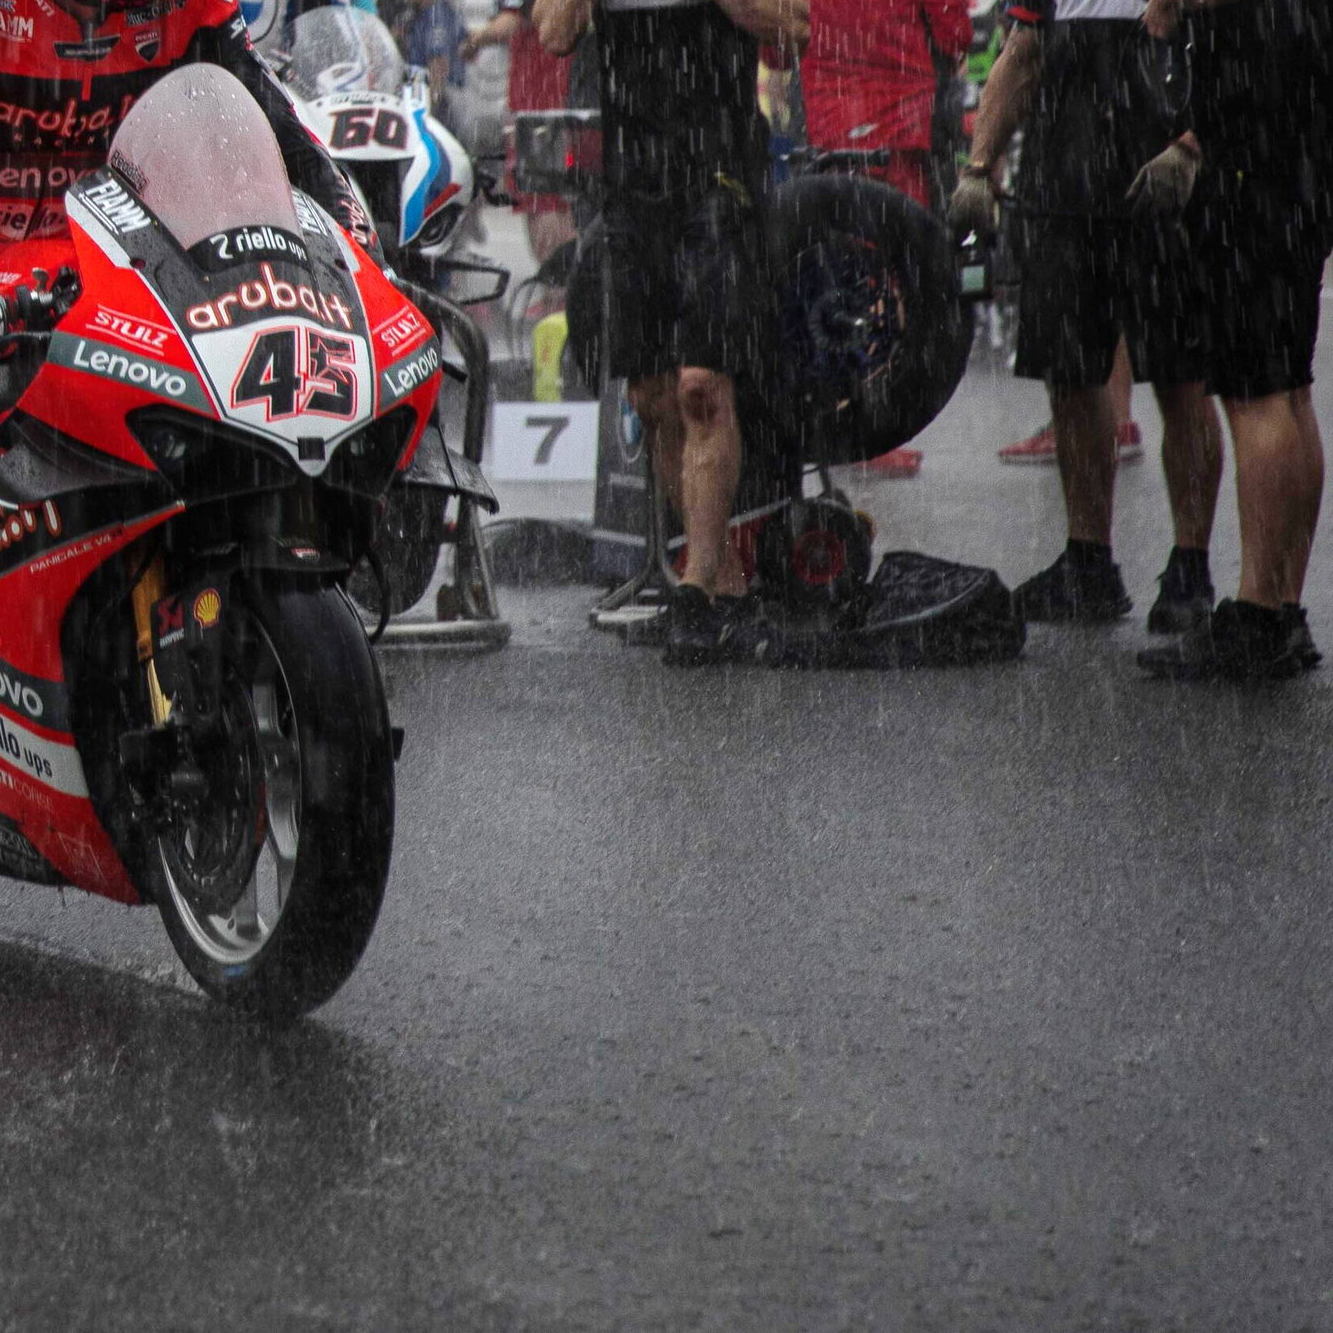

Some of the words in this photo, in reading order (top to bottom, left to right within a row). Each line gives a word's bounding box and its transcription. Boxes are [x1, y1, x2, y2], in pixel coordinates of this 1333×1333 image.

[328, 108, 409, 151] 60
[85, 178, 152, 234] FIAMM
[235, 226, 285, 252] riello
[288, 240, 308, 262] ups
[95, 311, 169, 348] STULZ
[73, 339, 187, 397] Lenovo
[230, 324, 358, 424] 45
[383, 346, 438, 398] Lenovo
[524, 415, 570, 465] 7
[30, 542, 94, 574] PANIGALE
[24, 749, 54, 779] ups
